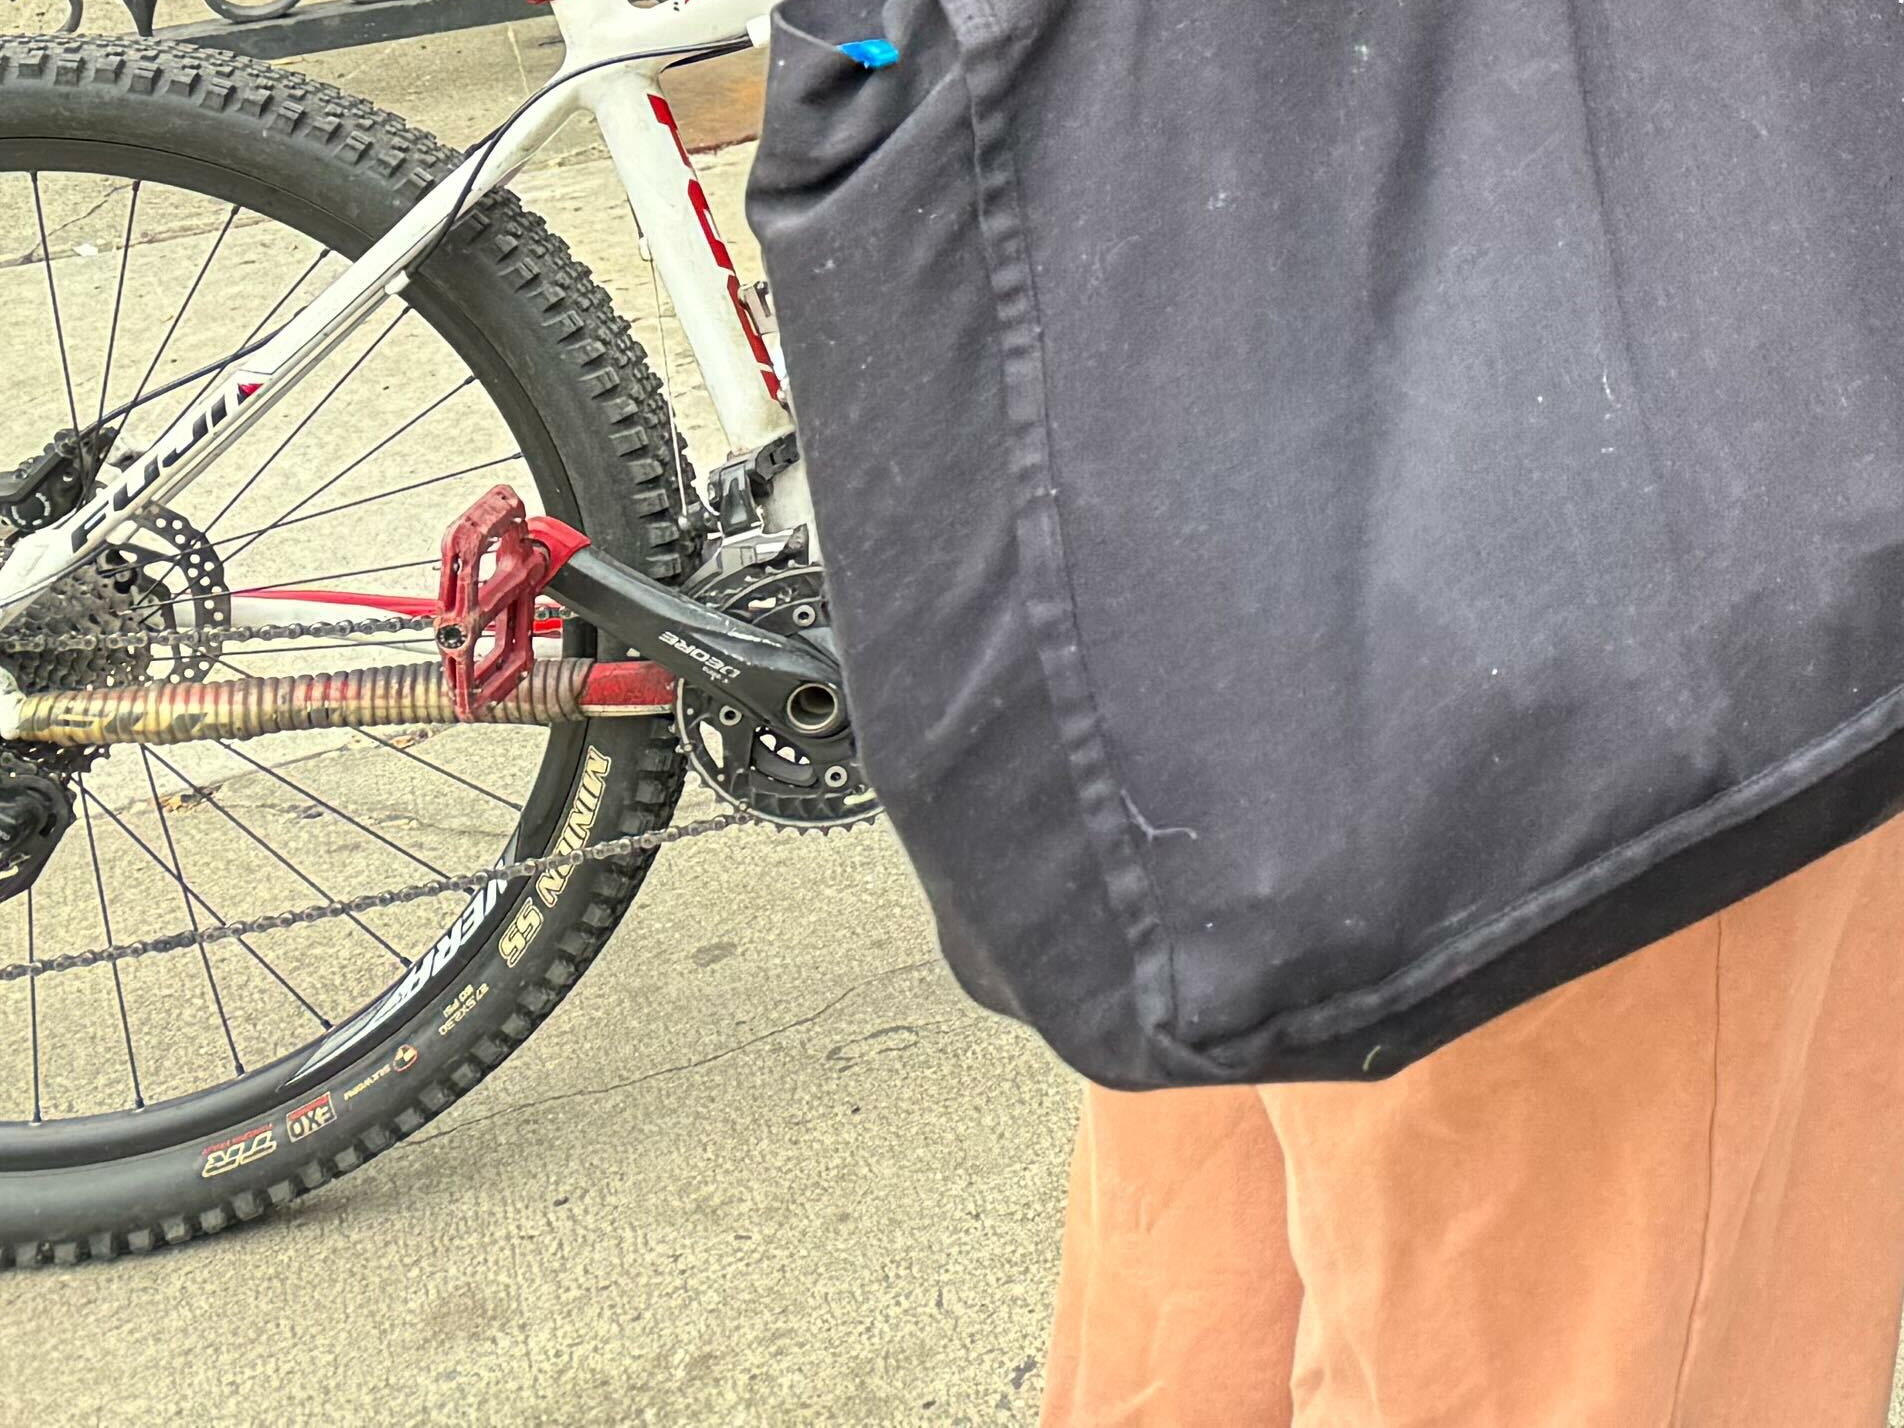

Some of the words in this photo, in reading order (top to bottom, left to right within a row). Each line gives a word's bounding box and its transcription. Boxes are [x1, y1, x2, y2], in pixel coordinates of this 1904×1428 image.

[657, 631, 742, 679] DEORE
[498, 896, 545, 968] SS
[288, 1104, 333, 1140] EXO
